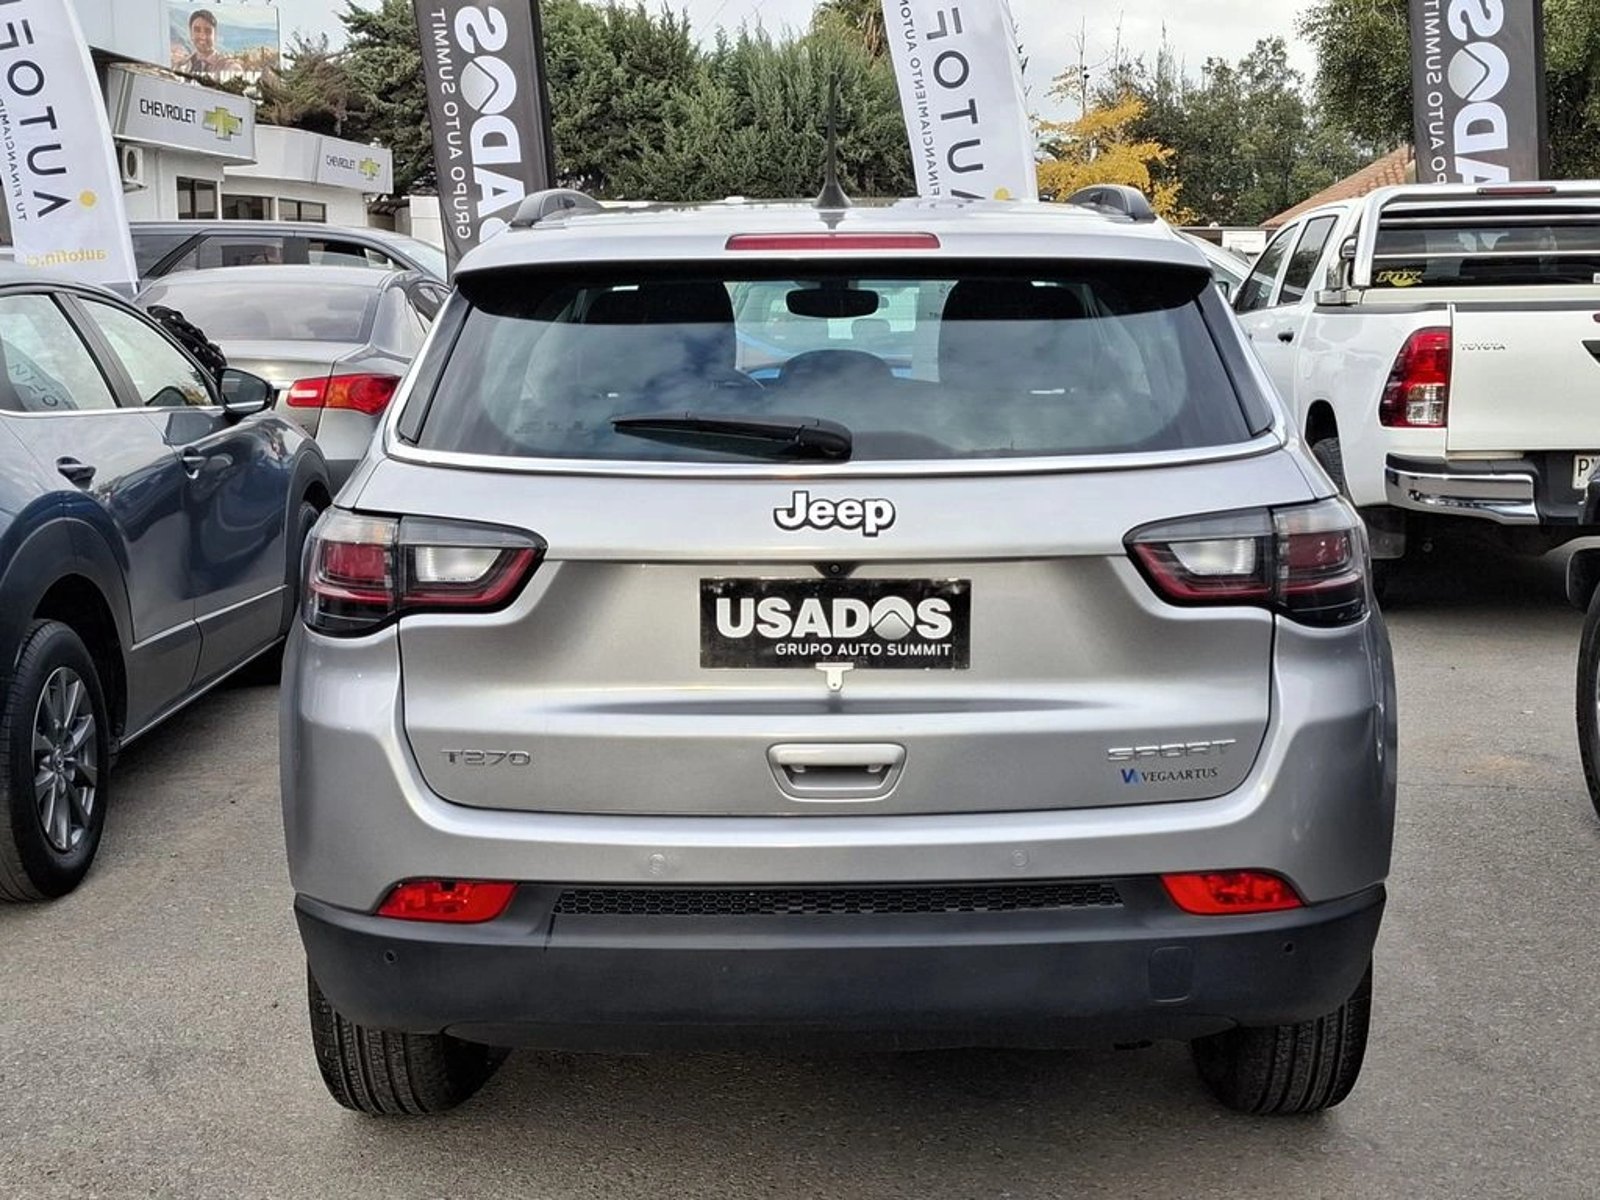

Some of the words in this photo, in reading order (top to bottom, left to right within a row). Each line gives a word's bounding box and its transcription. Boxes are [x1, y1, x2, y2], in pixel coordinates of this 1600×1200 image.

[140, 98, 196, 124] CHEVROLET
[774, 491, 895, 537] Jeep
[716, 596, 952, 641] USADOS
[775, 643, 833, 656] GRUPO
[837, 643, 882, 656] AUTO
[887, 643, 952, 656] SUMMIT
[440, 749, 531, 766] T270
[1108, 738, 1237, 762] SPORT
[1141, 767, 1218, 783] VEGAARTUS
